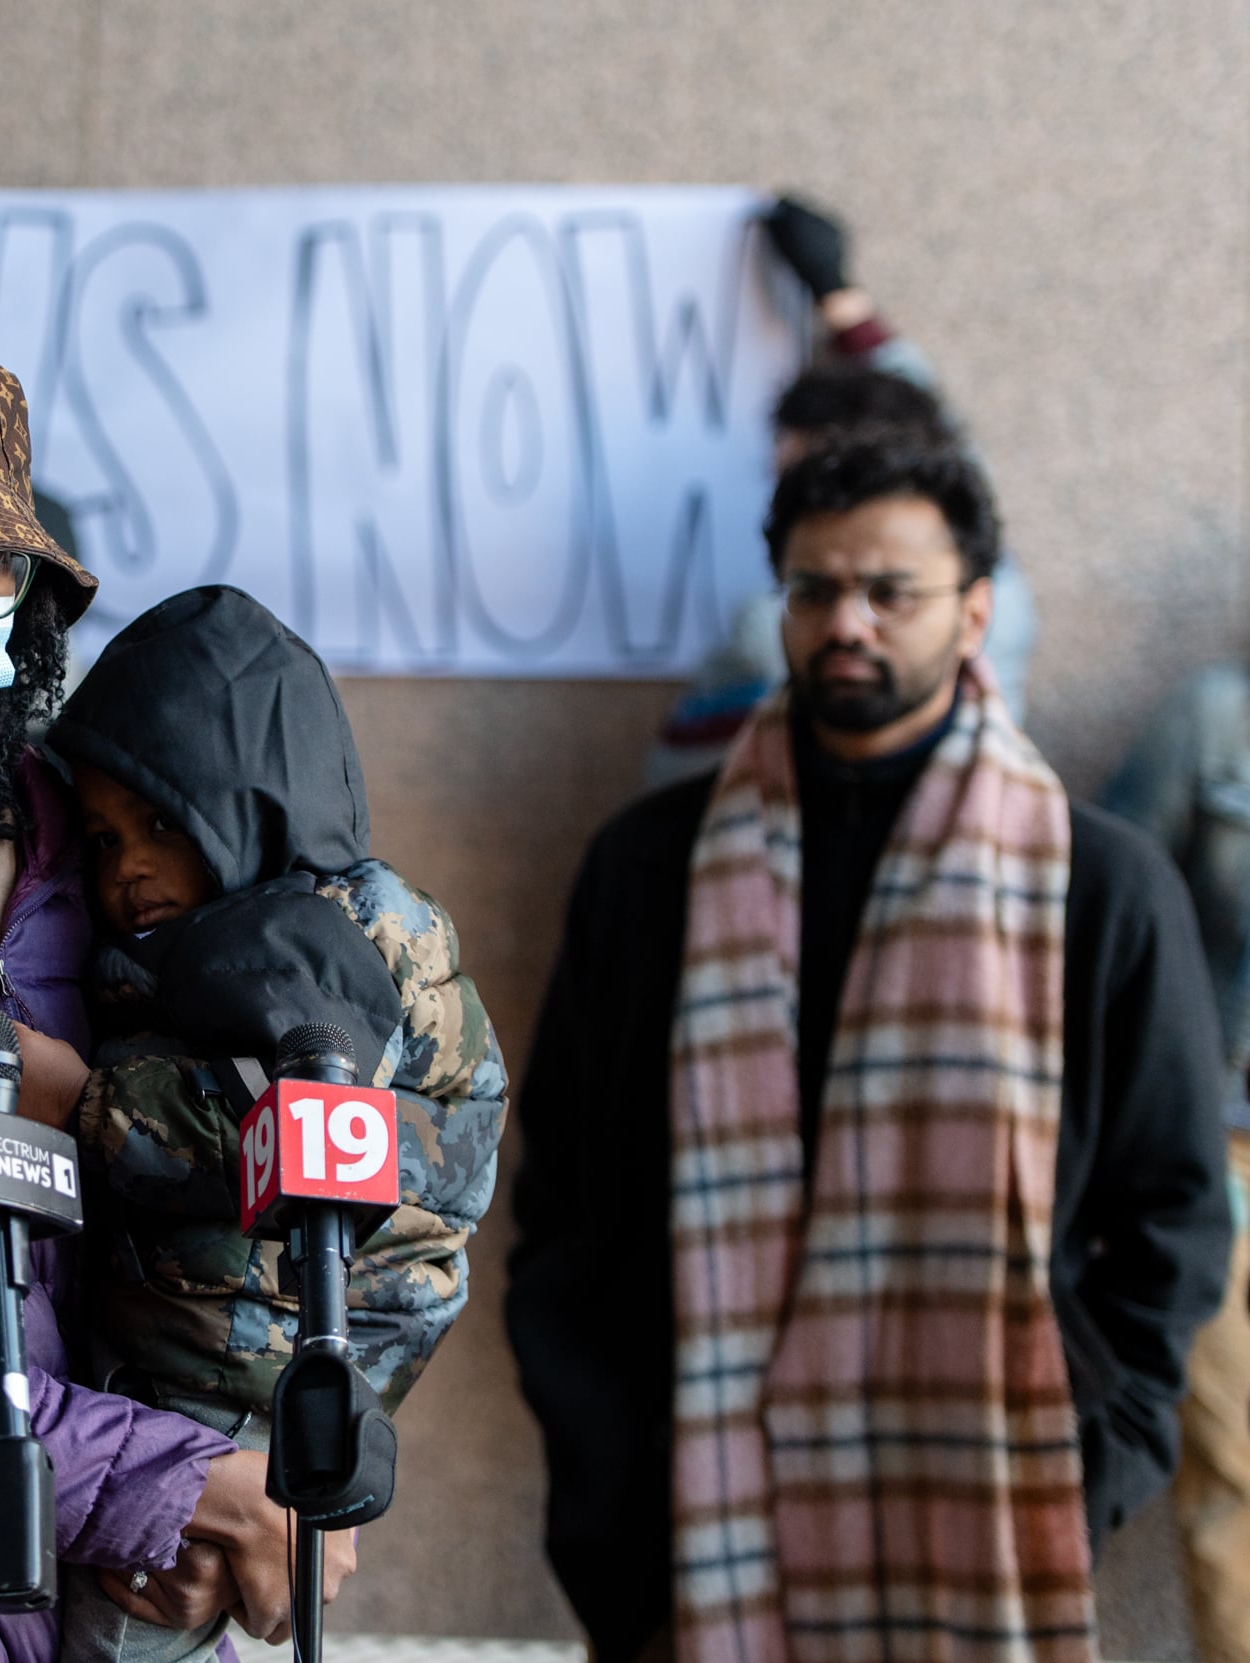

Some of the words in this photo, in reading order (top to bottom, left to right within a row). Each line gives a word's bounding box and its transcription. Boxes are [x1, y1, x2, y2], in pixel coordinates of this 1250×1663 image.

[287, 208, 756, 661] NOW
[243, 1106, 275, 1210] 19
[288, 1098, 389, 1183] 19
